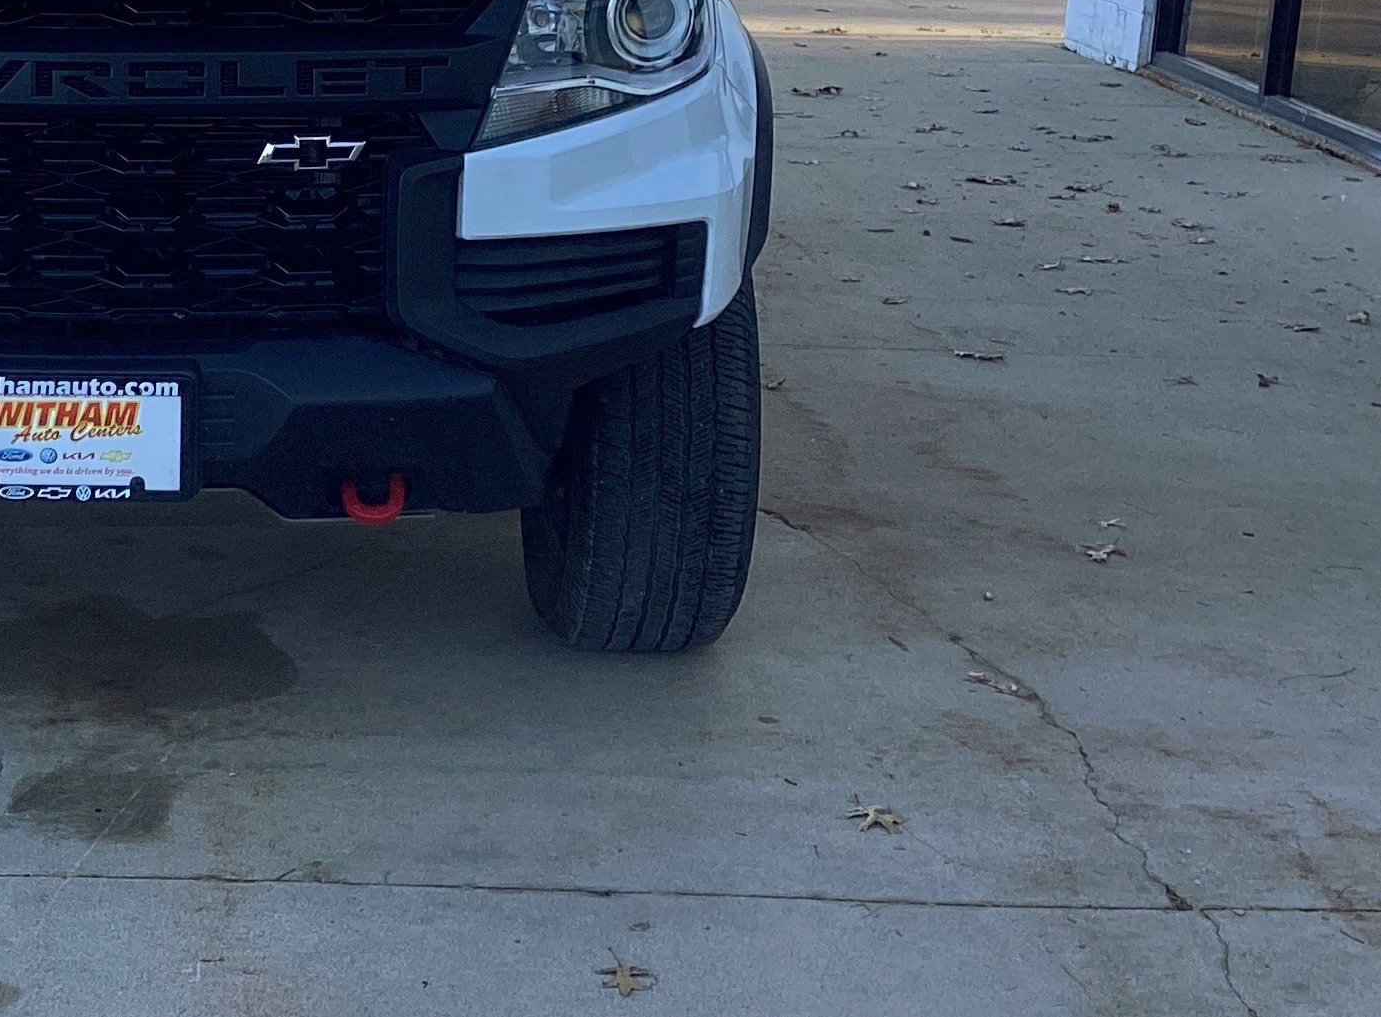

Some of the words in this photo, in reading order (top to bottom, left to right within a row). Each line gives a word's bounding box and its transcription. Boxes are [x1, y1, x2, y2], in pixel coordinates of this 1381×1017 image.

[11, 426, 62, 444] Auto
[70, 422, 143, 442] Centers
[54, 467, 65, 475] do
[66, 467, 74, 475] is
[75, 467, 103, 475] driven
[105, 467, 114, 477] by
[95, 488, 131, 499] KIA
